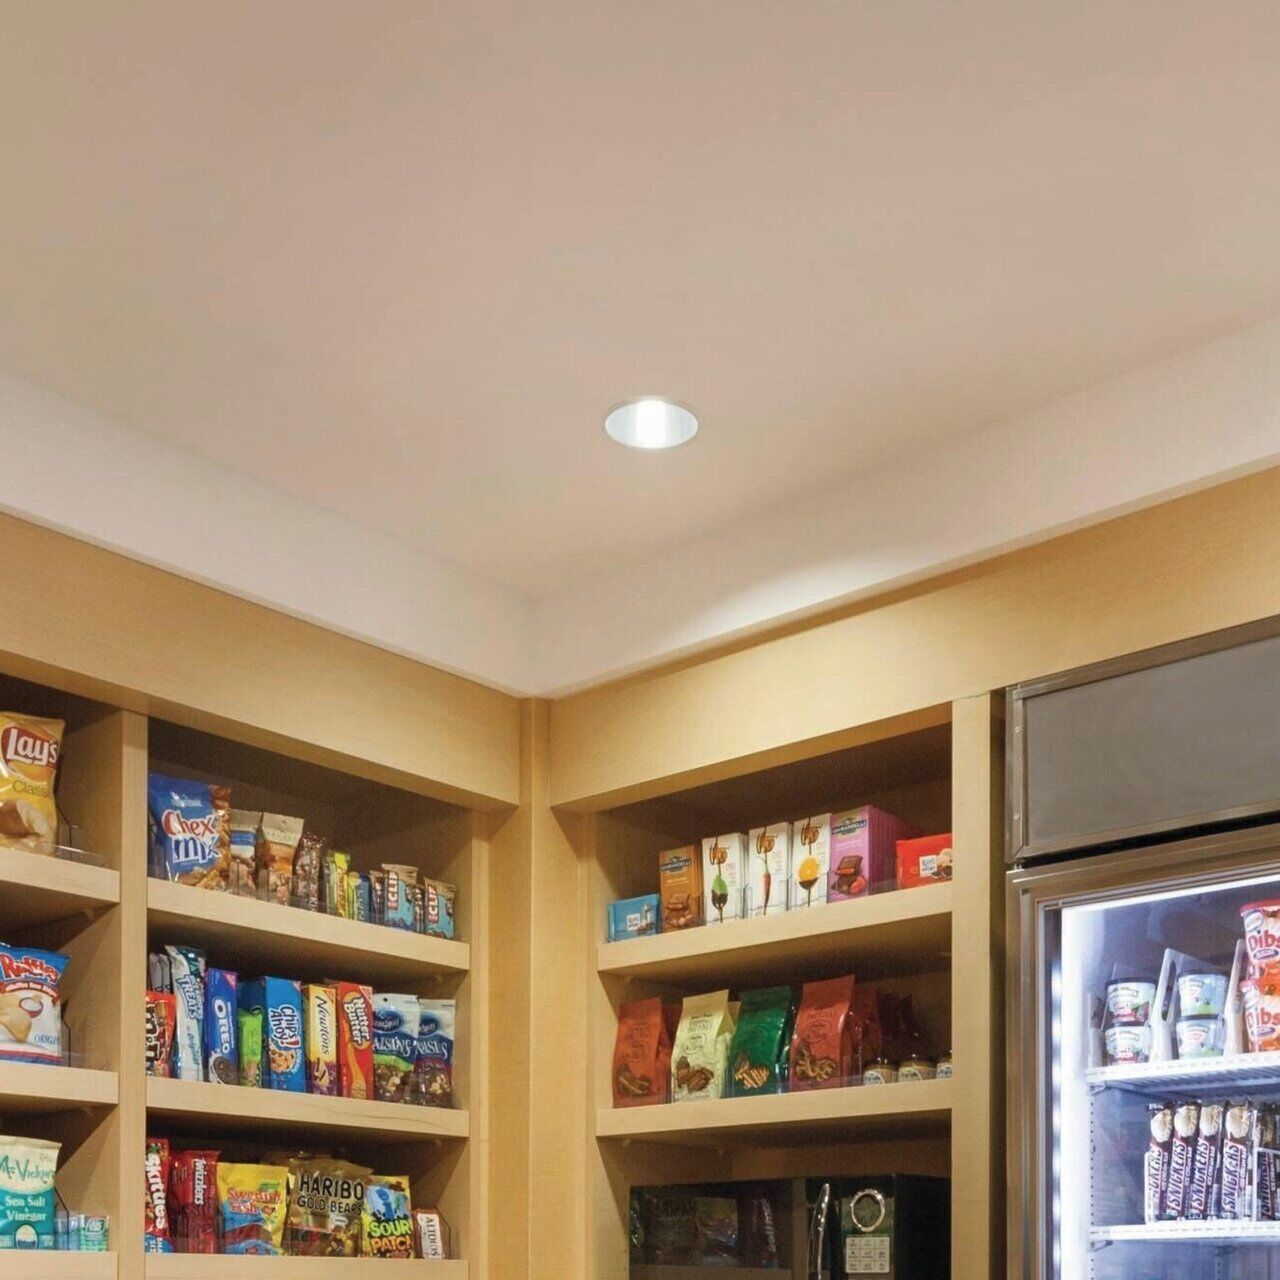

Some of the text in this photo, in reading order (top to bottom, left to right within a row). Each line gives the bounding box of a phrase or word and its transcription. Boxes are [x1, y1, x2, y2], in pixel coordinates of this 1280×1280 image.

[6, 728, 59, 766] Lay's
[163, 807, 216, 838] Chex
[177, 976, 198, 1020] TREATS
[354, 996, 370, 1040] Nutter
[213, 999, 231, 1054] OREO
[316, 995, 331, 1055] Newtons
[343, 1001, 362, 1046] Butter
[145, 1152, 167, 1230] Skittles
[227, 1187, 281, 1203] Swedish
[300, 1172, 365, 1201] HARIBO
[1167, 1141, 1187, 1209] SNICKERS
[1191, 1141, 1210, 1209] SNICKERS
[1223, 1144, 1240, 1212] SNICKERS
[4, 1195, 46, 1207] Sea Salt
[6, 1210, 47, 1222] Vinegar
[370, 1219, 411, 1236] SOUR
